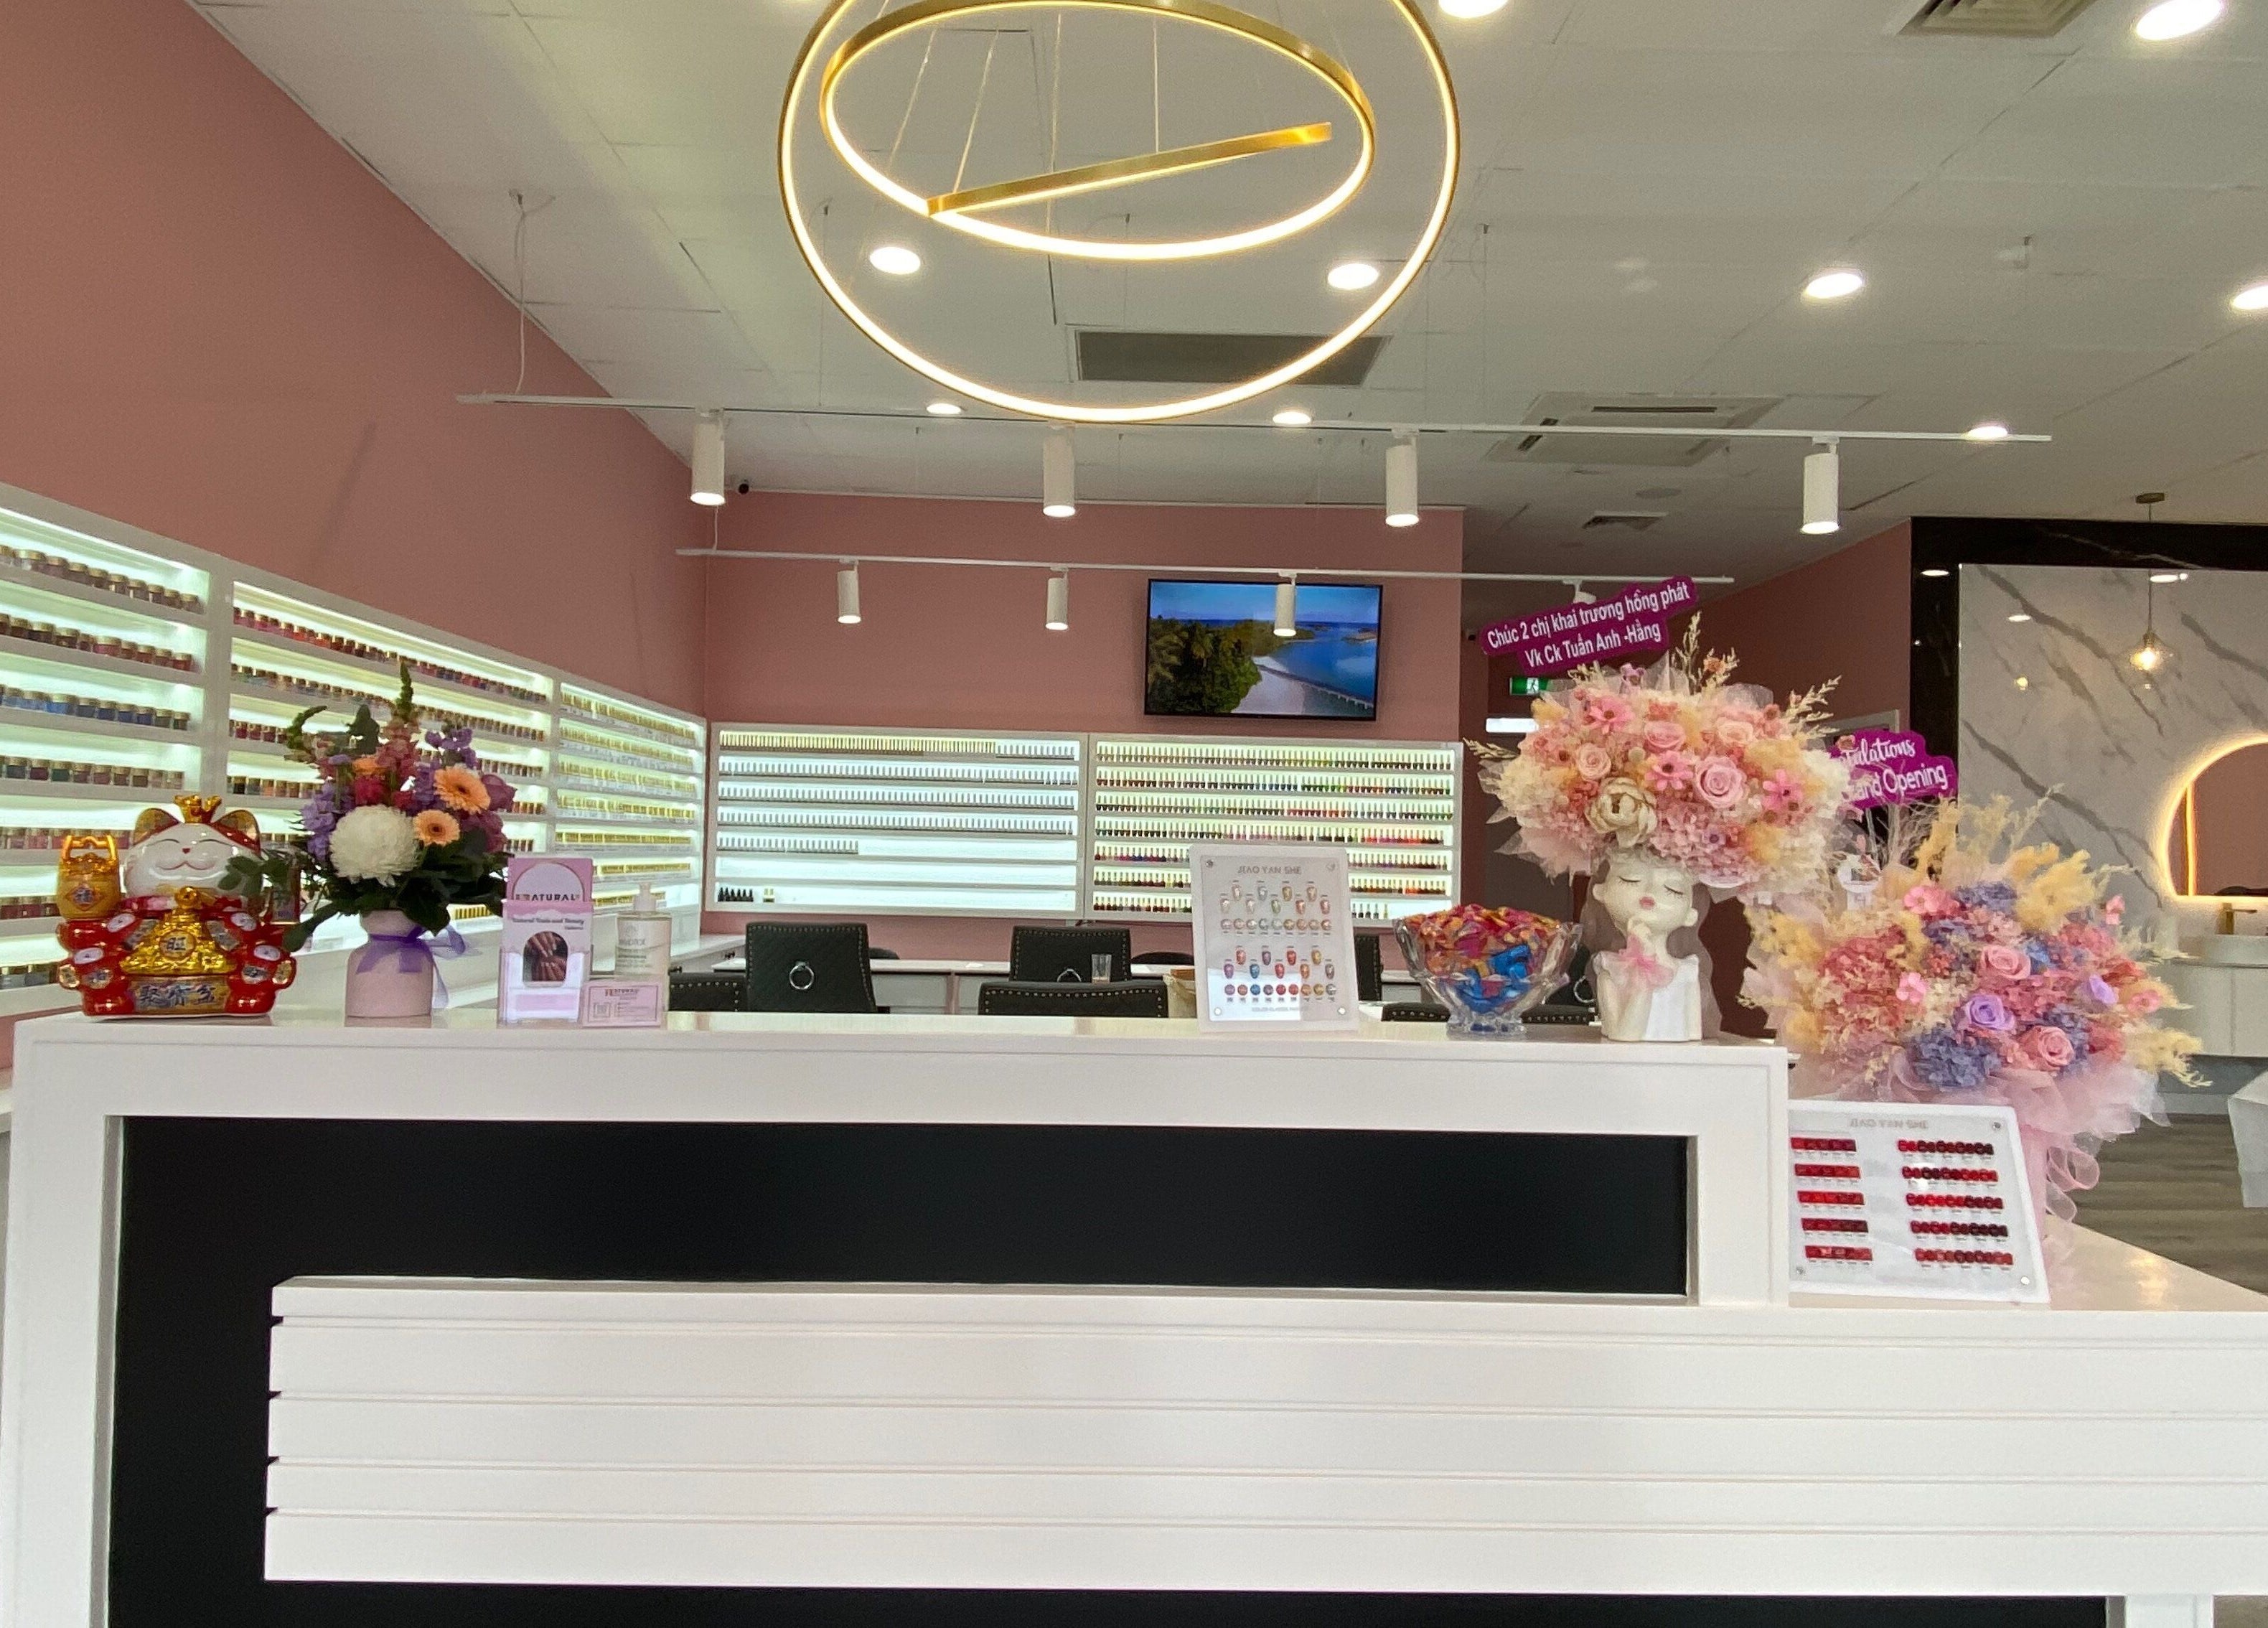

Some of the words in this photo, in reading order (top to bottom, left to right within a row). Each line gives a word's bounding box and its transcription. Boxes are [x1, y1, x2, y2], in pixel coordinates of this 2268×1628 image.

[1487, 624, 1519, 648] Chúc
[1519, 622, 1530, 640] 2
[1531, 617, 1552, 638] chị
[1552, 609, 1578, 632] khai
[1579, 601, 1625, 625] trương
[1624, 589, 1659, 612] hồng
[1659, 581, 1690, 609] phát
[1524, 648, 1544, 668] Vk
[1544, 644, 1563, 663] Ck
[1561, 632, 1594, 659] Tuấn
[1596, 629, 1621, 652] Anh
[1883, 763, 1948, 797] Opening
